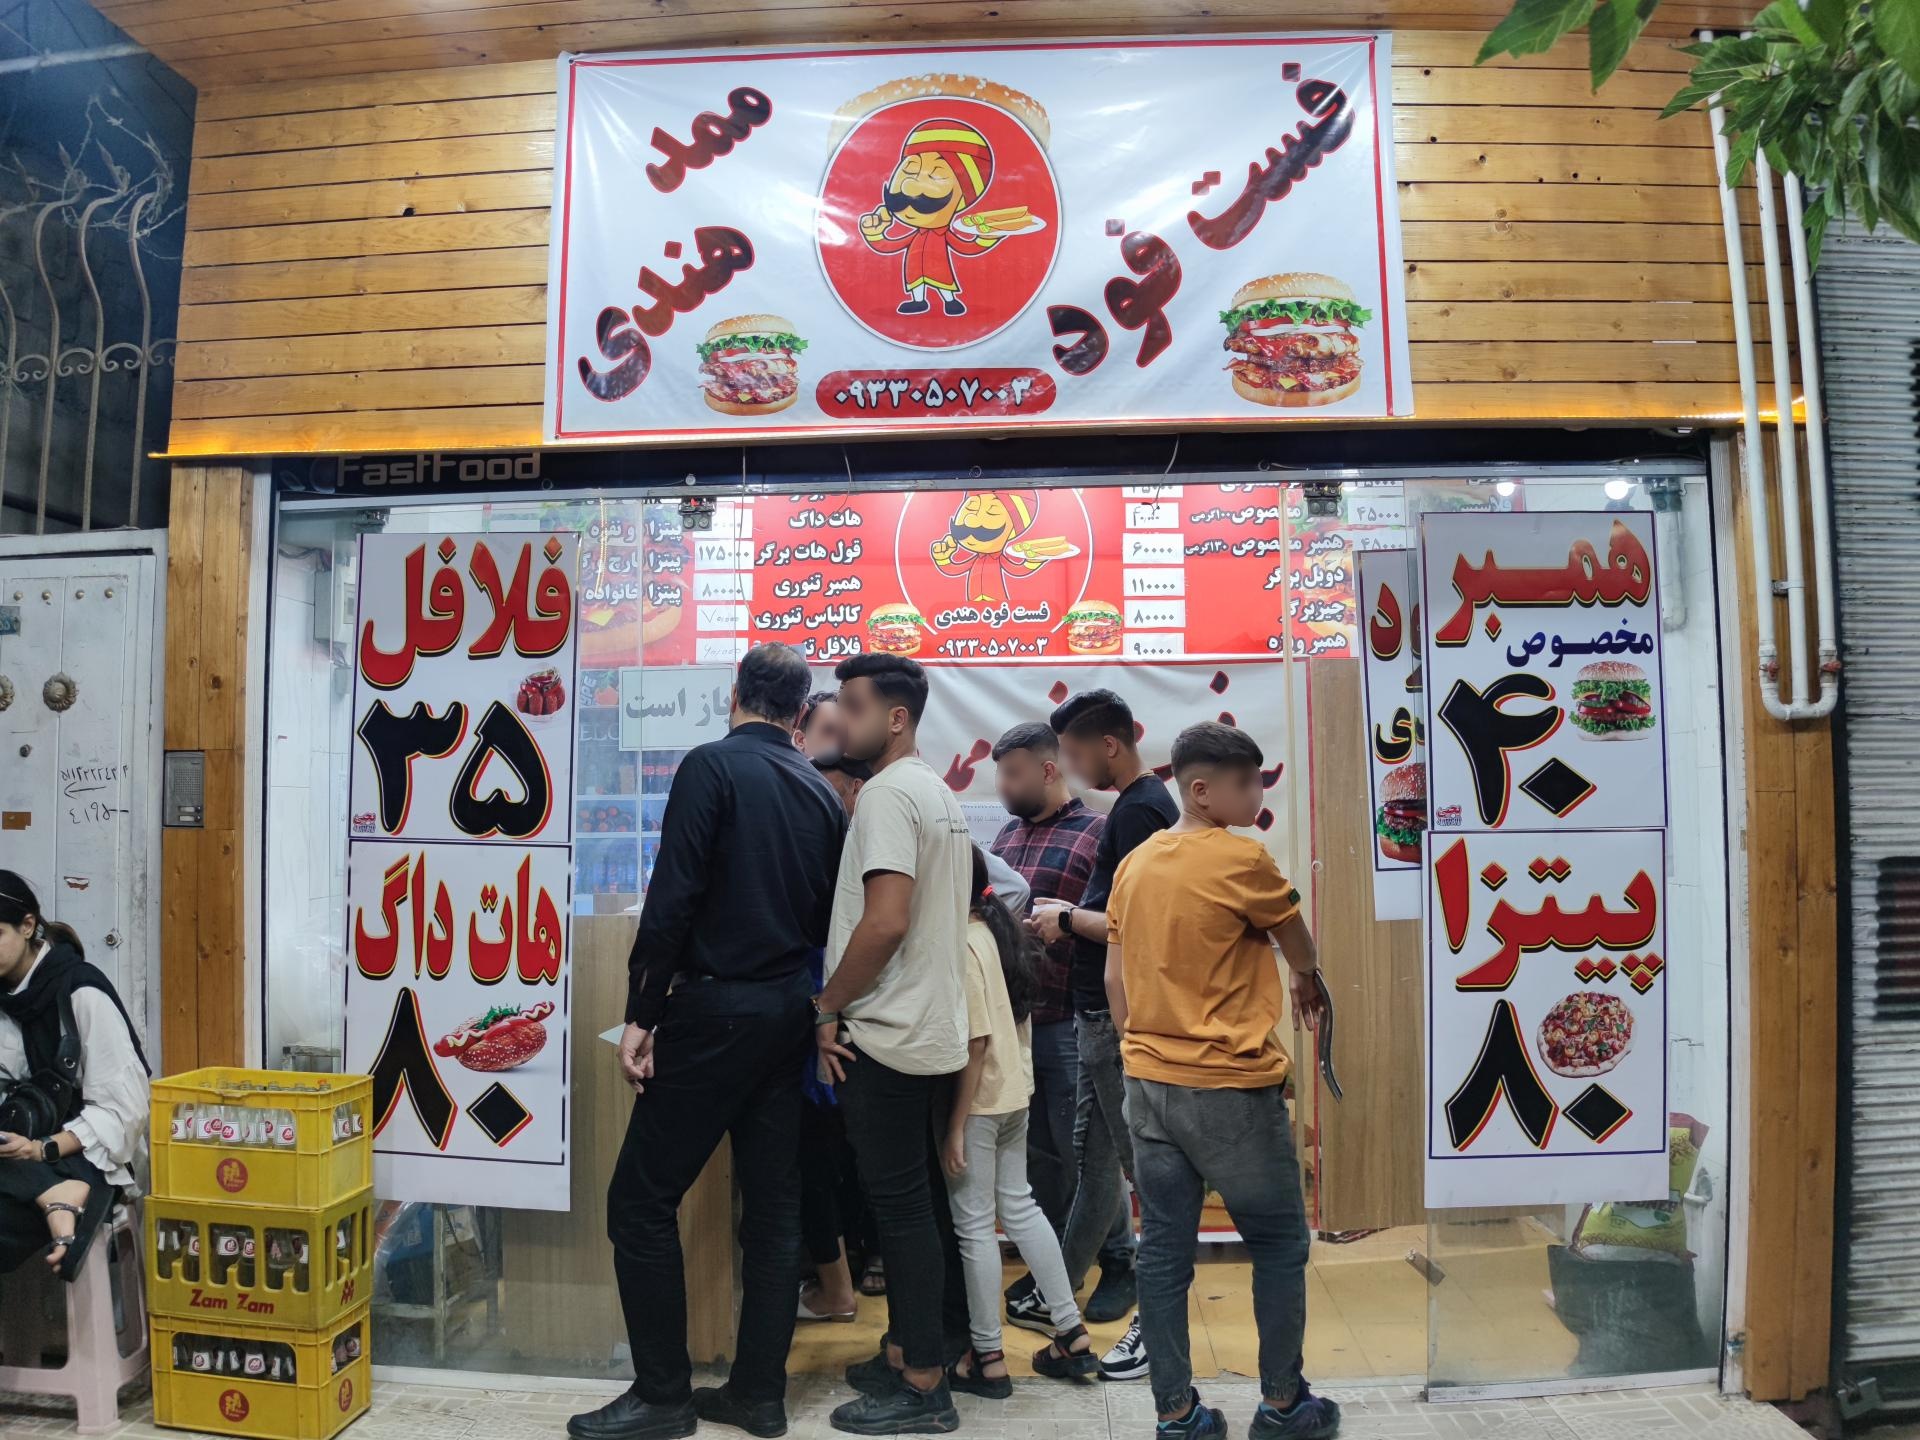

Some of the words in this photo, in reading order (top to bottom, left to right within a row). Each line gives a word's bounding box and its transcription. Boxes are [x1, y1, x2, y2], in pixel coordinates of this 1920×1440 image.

[645, 86, 773, 193] ممد
[1187, 62, 1355, 250] فست
[1047, 219, 1182, 376] فود
[578, 225, 755, 402] هندی
[834, 375, 1034, 409] ۰۹۳۳۰۵۰۷۰۰۳
[789, 509, 826, 529] داگ
[828, 508, 862, 528] هات
[1357, 506, 1400, 522] ۴۵۰۰۰
[649, 519, 682, 542] پیتزا
[698, 545, 750, 562] ۱۷۵۰۰۰
[755, 542, 791, 566] برگر
[794, 541, 827, 561] هات
[830, 538, 862, 564] قول
[1132, 541, 1173, 557] ۶۰۰۰۰
[1307, 534, 1345, 557] همبر
[649, 550, 682, 573] پیتزا
[774, 573, 822, 598] تنوری
[824, 575, 862, 596] همبر
[1132, 577, 1176, 593] ۱۱۰۰۰۰
[1304, 563, 1345, 588] دوبل
[1435, 519, 1652, 648] همبر
[648, 582, 682, 605] پیتزا
[702, 583, 742, 597] ۸۰۰۰۰
[360, 536, 571, 691] فلافل
[755, 606, 803, 630] تنوری
[804, 604, 862, 629] کالباس
[935, 607, 979, 628] هندی
[982, 602, 1009, 626] فود
[1012, 602, 1049, 623] فست
[1134, 608, 1175, 624] ۸۰۰۰۰
[818, 635, 862, 660] فلافل
[937, 637, 1049, 657] ۰۹۳۳۰۵۰۷۰۰۳
[1133, 642, 1173, 655] ۹۰۰۰۰
[1309, 632, 1347, 654] همبر
[1506, 617, 1655, 668] مخصوص
[625, 687, 687, 719] است
[1437, 673, 1597, 828] ۴۰
[357, 698, 553, 839] ۳۵
[355, 850, 454, 981] داگ
[469, 853, 562, 986] هات
[1434, 837, 1664, 995] پیتزا
[367, 986, 533, 1151] ۸۰
[1444, 998, 1633, 1152] ۸۰
[189, 1288, 228, 1310] Zam
[236, 1293, 275, 1314] Zam
